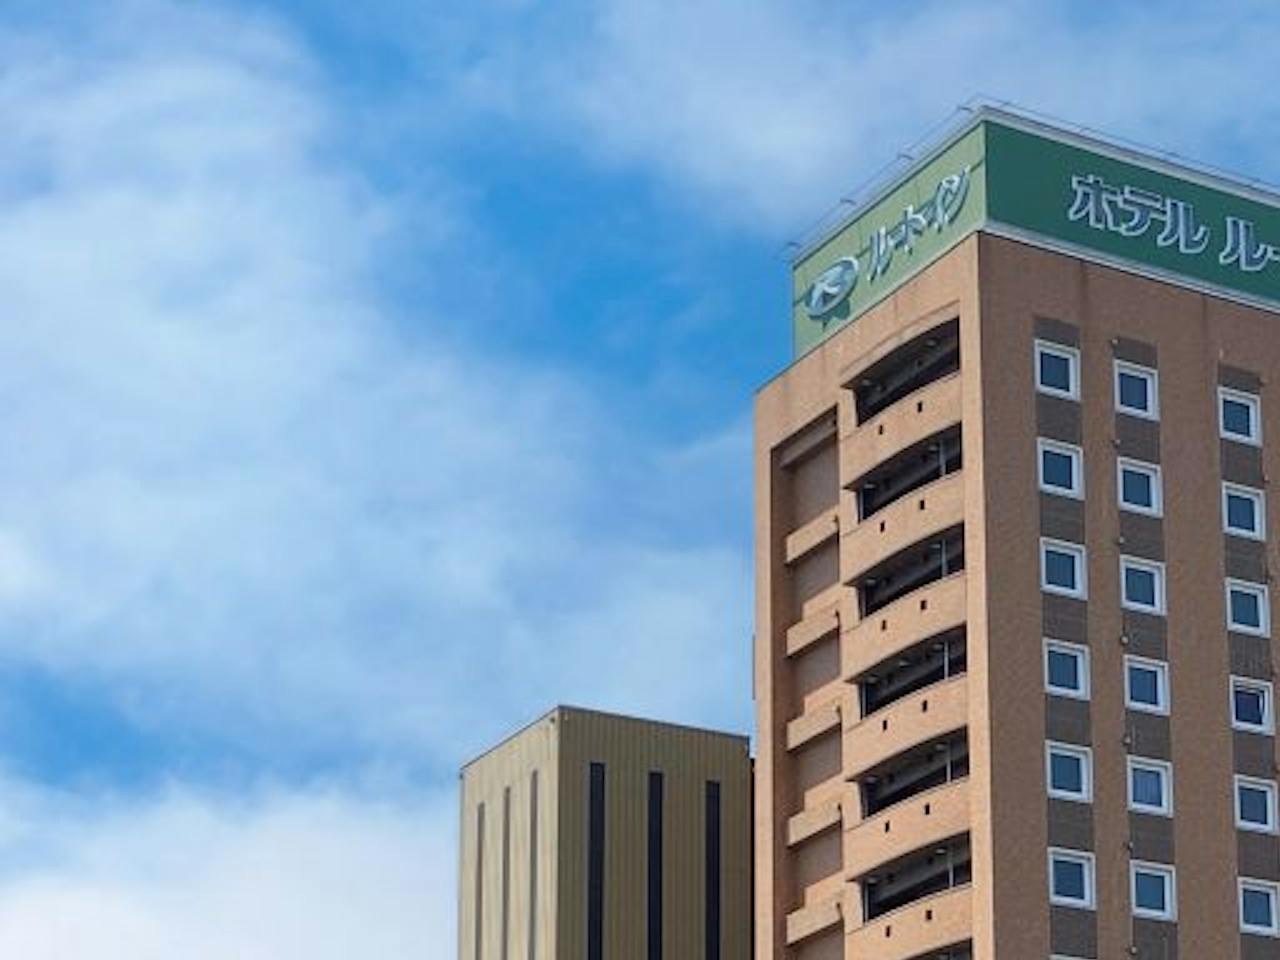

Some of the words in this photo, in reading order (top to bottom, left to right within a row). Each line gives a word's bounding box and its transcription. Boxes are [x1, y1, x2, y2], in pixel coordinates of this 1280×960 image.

[866, 166, 972, 281] ルートイン
[1067, 175, 1210, 255] ホテル
